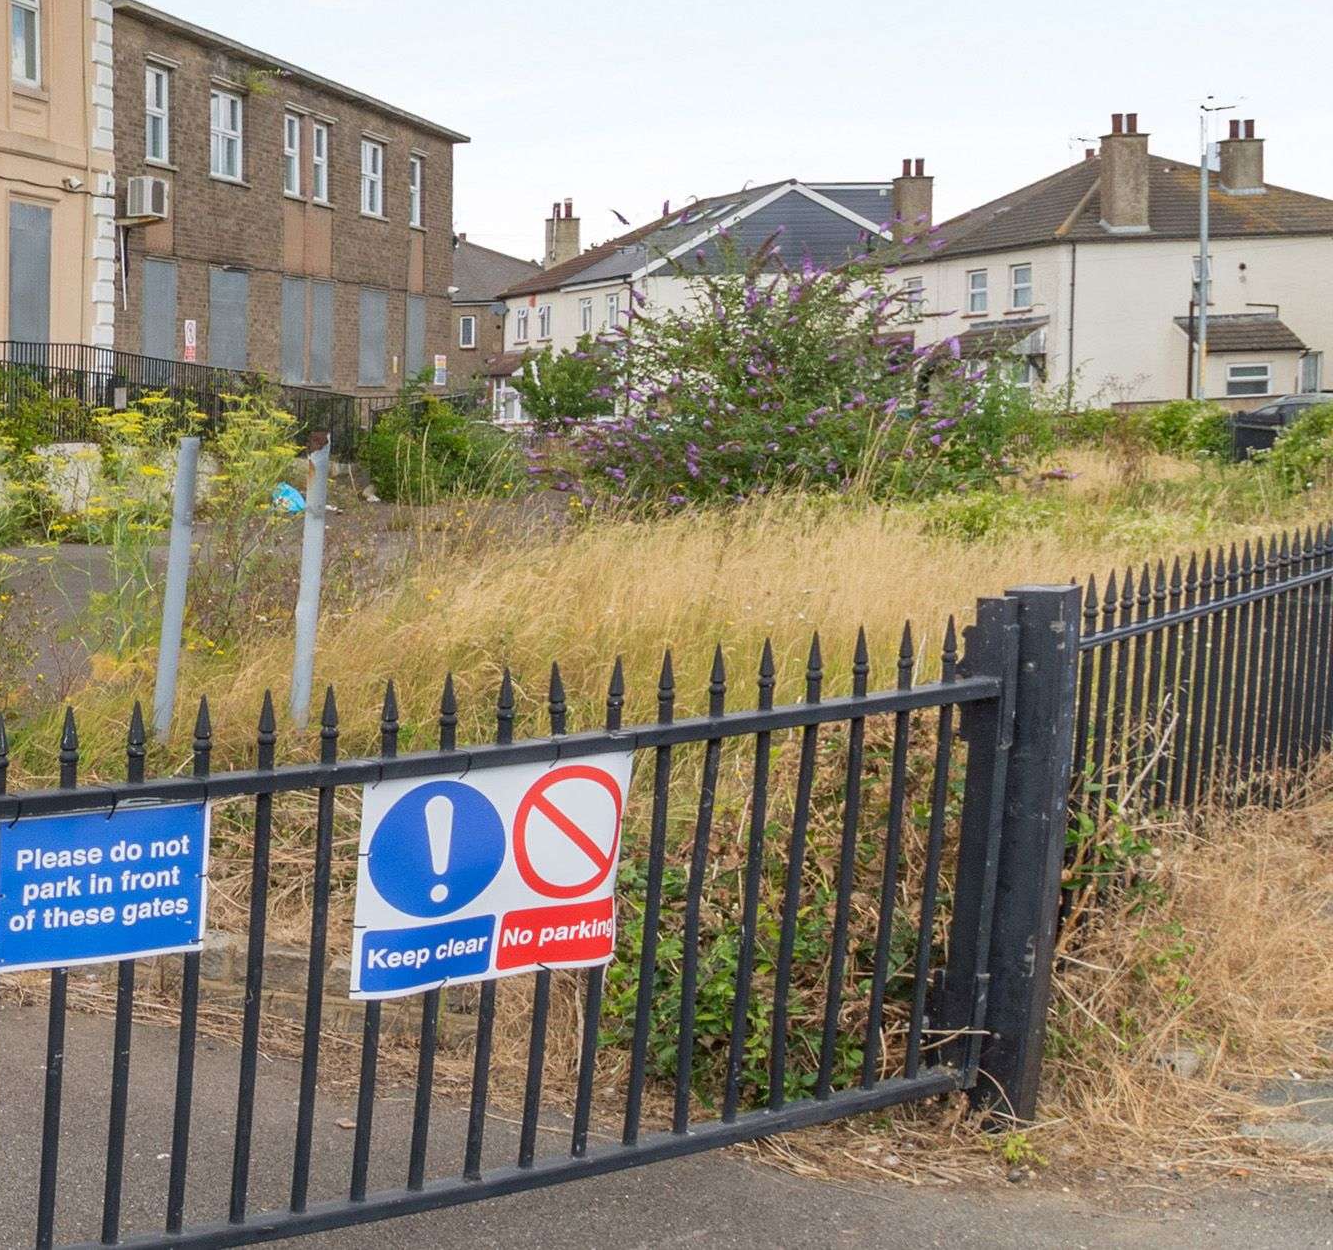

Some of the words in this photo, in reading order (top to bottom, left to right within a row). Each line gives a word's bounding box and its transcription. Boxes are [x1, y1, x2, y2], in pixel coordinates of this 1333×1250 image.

[16, 846, 103, 871] Please
[110, 840, 143, 863] do
[150, 834, 190, 859] not
[22, 875, 82, 906] park
[89, 873, 112, 895] in
[121, 865, 181, 892] front
[9, 909, 36, 932] of
[43, 906, 115, 929] these
[122, 897, 189, 926] gates
[501, 927, 533, 948] No
[538, 918, 613, 946] parking
[367, 947, 430, 969] Keep
[435, 935, 488, 960] clear
